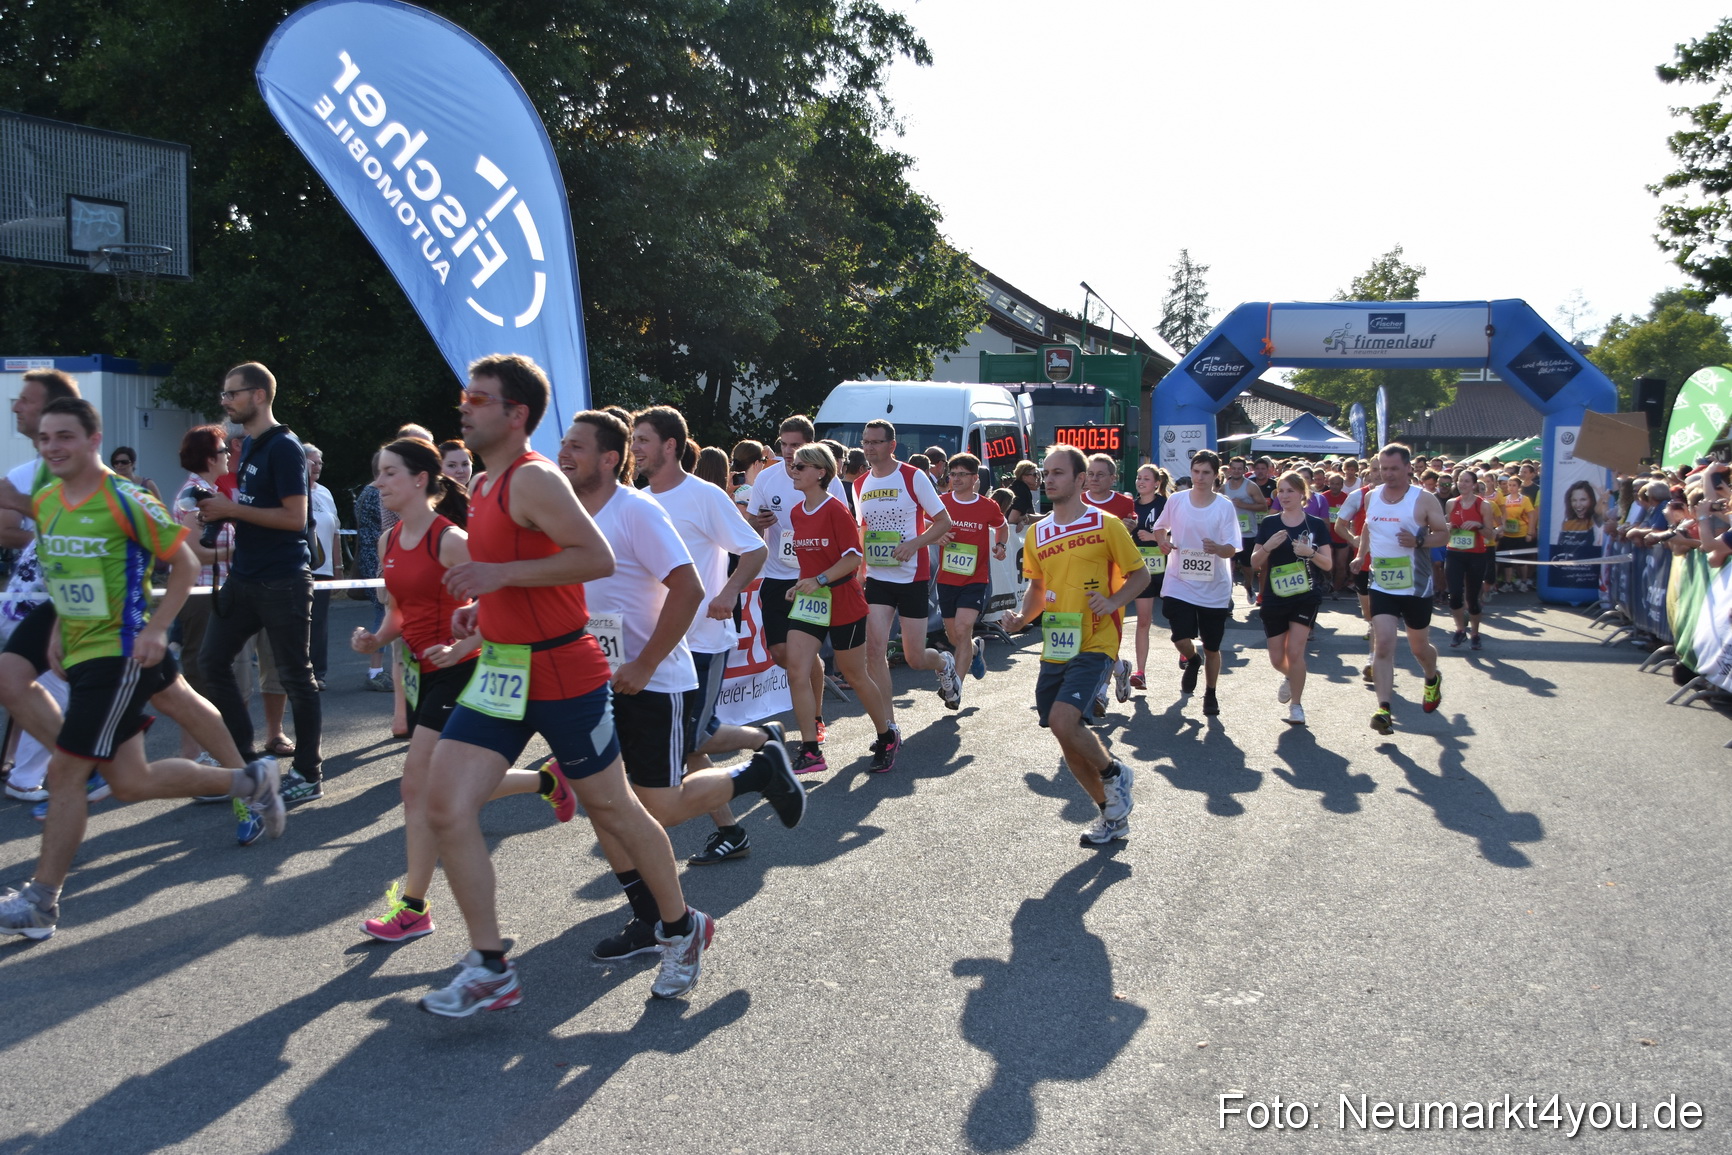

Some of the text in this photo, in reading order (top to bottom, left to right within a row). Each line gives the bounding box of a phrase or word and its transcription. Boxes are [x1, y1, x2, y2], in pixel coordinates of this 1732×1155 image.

[1376, 319, 1403, 327] Fischer
[1354, 334, 1436, 349] firmenlauf
[1202, 363, 1244, 372] Fischer
[1668, 423, 1702, 454] AOK
[862, 490, 895, 500] ONLINE
[951, 521, 977, 529] MARKT
[1452, 536, 1472, 545] 1383
[867, 545, 896, 557] 1027
[1038, 535, 1105, 561] MAX BÖGL
[946, 553, 974, 567] 1407
[1182, 558, 1212, 572] 8932
[1275, 574, 1305, 590] 1146
[1381, 570, 1404, 581] 574
[59, 583, 95, 603] 150
[798, 598, 828, 615] 1408
[1051, 631, 1075, 648] 944
[480, 671, 523, 699] 1372
